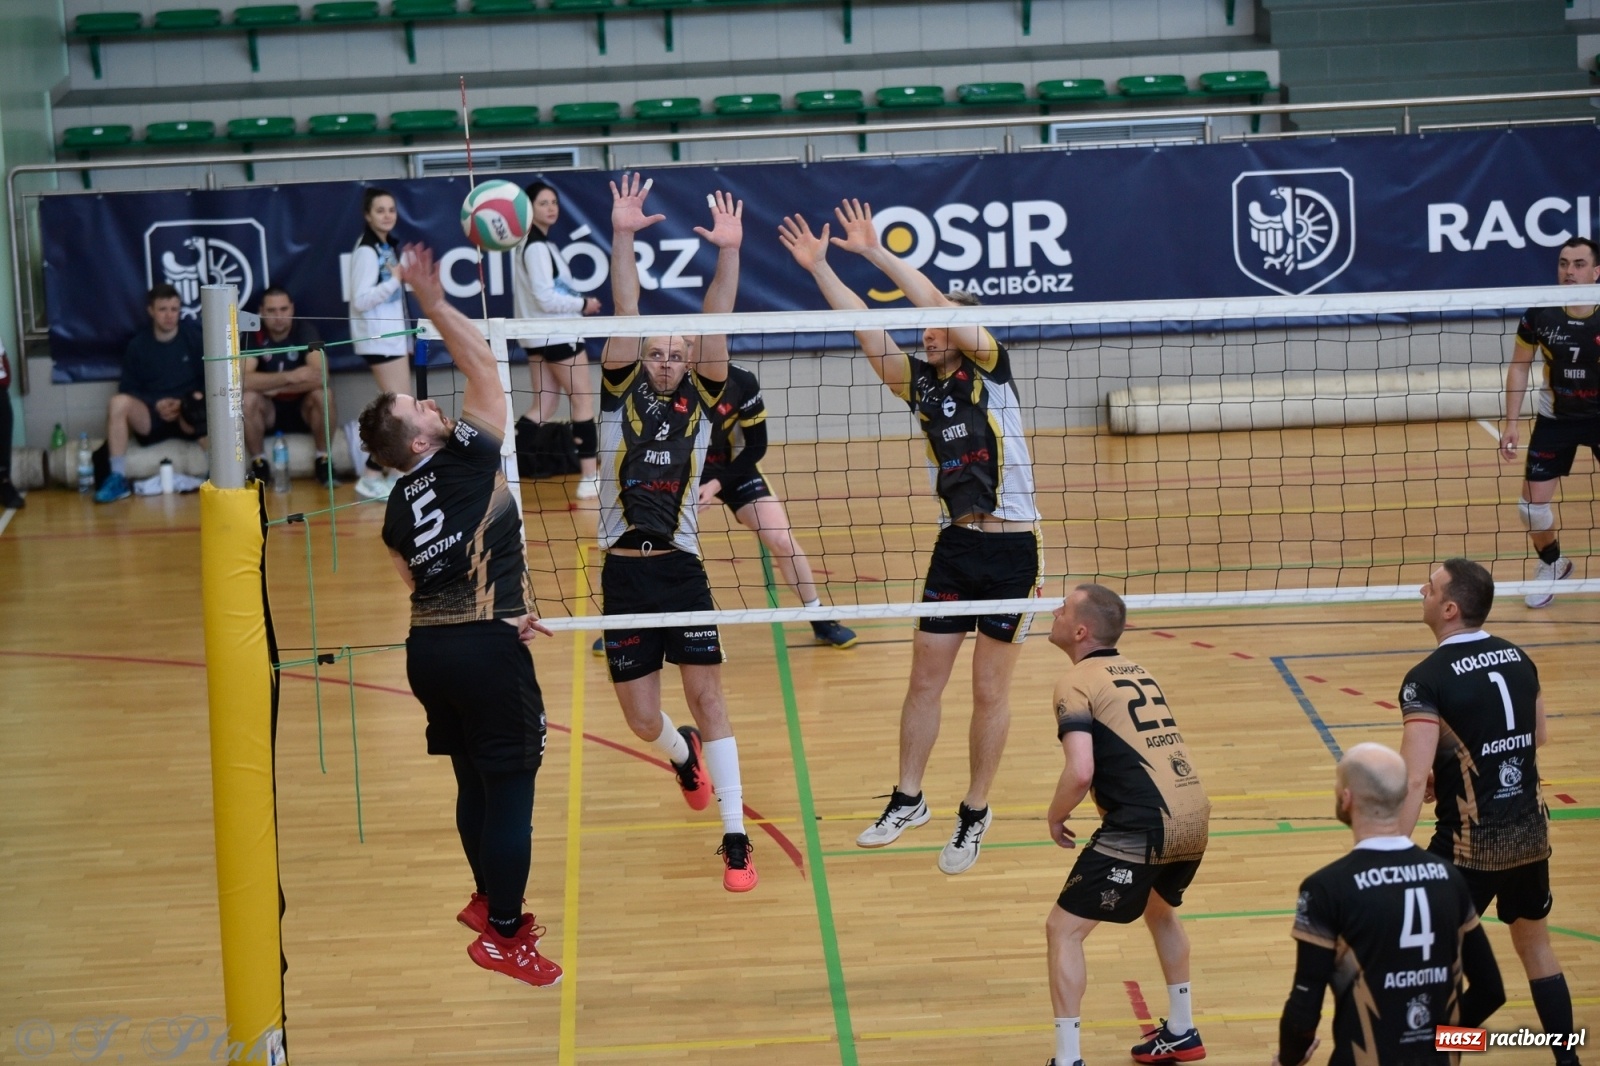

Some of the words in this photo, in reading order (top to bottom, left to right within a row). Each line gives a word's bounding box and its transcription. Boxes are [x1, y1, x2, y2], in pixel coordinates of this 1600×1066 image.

[1427, 196, 1600, 252] RACI
[948, 269, 1074, 297] RACIBÓRZ
[1569, 347, 1580, 363] 7
[1564, 368, 1586, 379] ENTER
[941, 395, 957, 418] 6
[942, 423, 968, 442] ENTER
[644, 450, 671, 465] ENTER
[411, 488, 446, 548] 5
[1451, 648, 1522, 676] KOŁODZIEJ
[1112, 677, 1177, 733] 23
[1488, 671, 1516, 731] 1
[1481, 733, 1532, 757] AGROTIM
[1354, 862, 1449, 890] KOCZWARA
[1399, 887, 1435, 961] 4
[1384, 967, 1448, 990] AGROTIM
